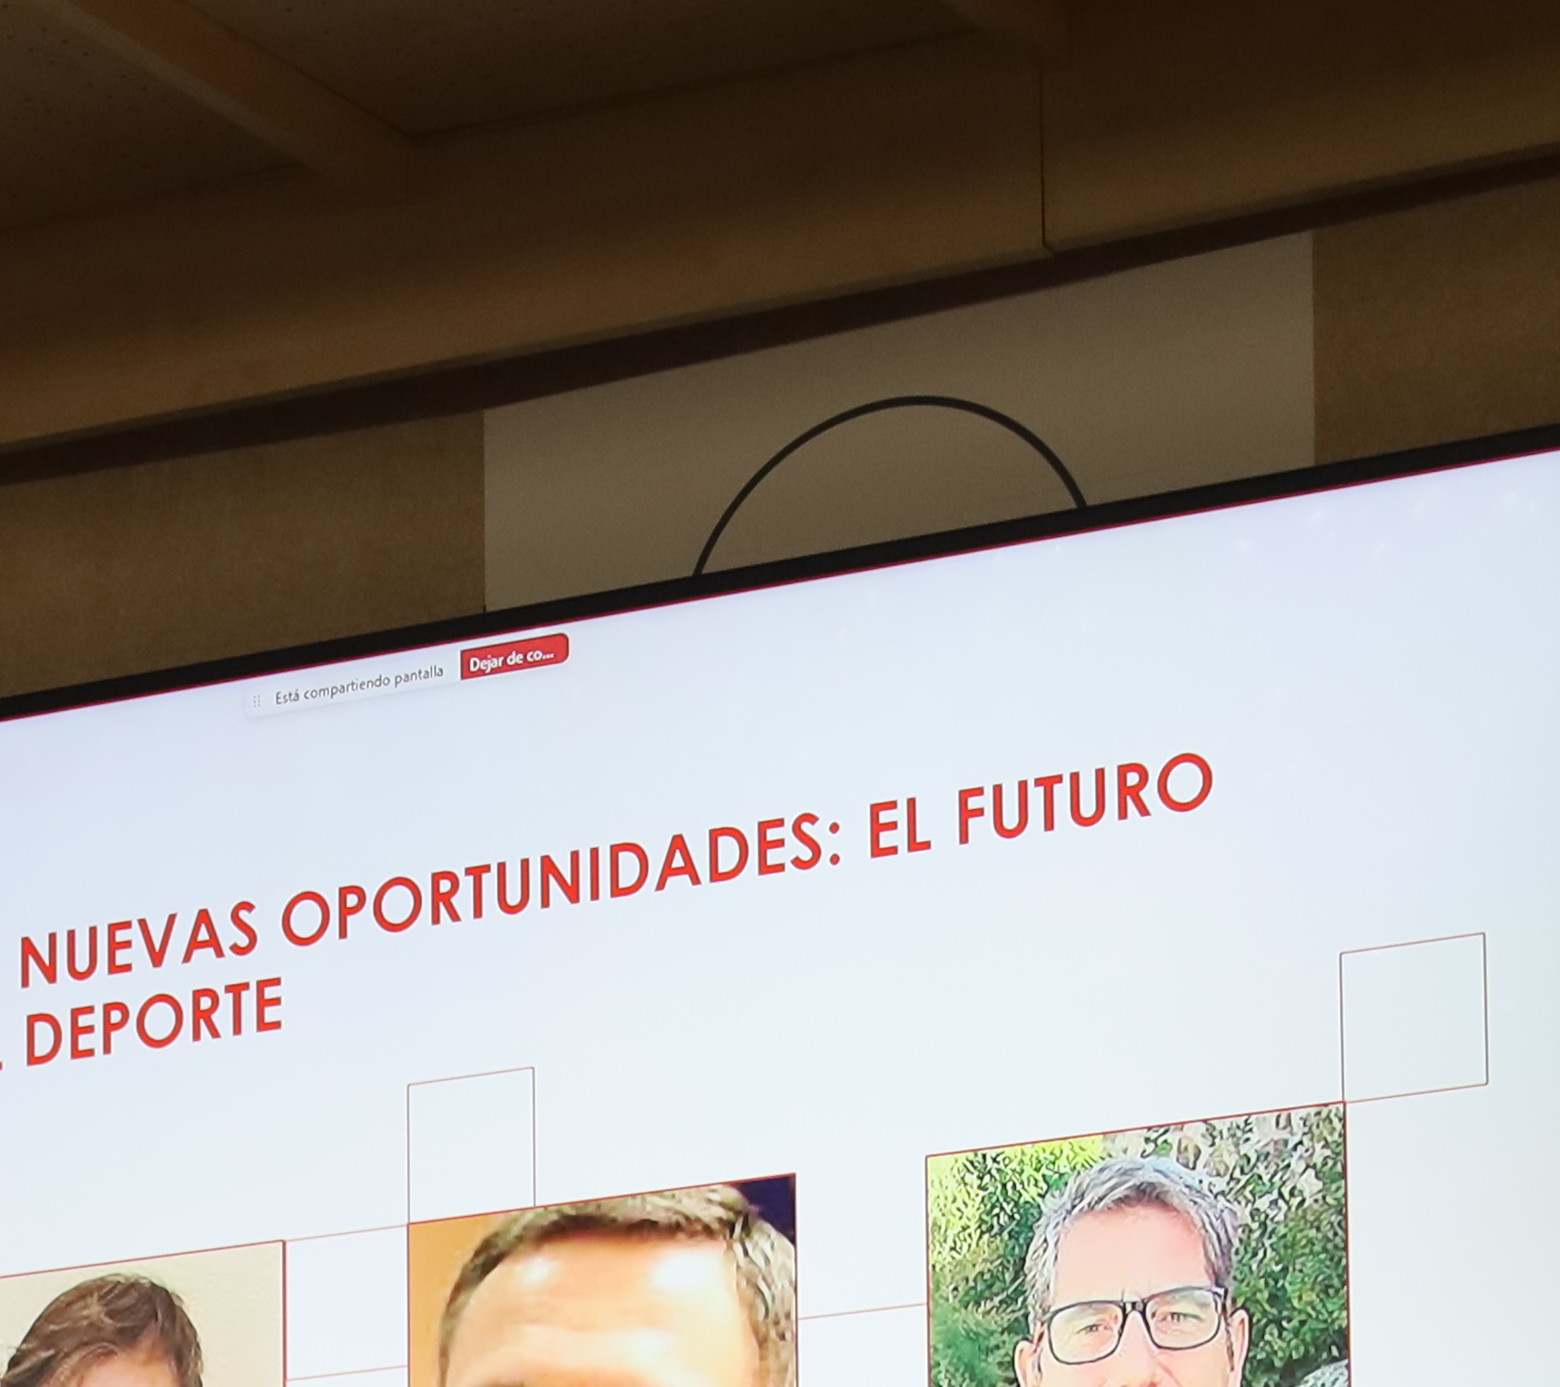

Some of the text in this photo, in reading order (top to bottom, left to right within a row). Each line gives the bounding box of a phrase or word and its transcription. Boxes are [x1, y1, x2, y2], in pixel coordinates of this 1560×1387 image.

[275, 665, 444, 705] Está compartiendo pantalla
[469, 655, 504, 674] Dejar
[507, 651, 524, 667] de
[21, 901, 257, 989] NUEVAS
[281, 811, 841, 948] OPORTUNIDADES:
[870, 797, 931, 858] EL
[958, 752, 1213, 845] FUTURO
[26, 976, 283, 1069] DEPORTE
